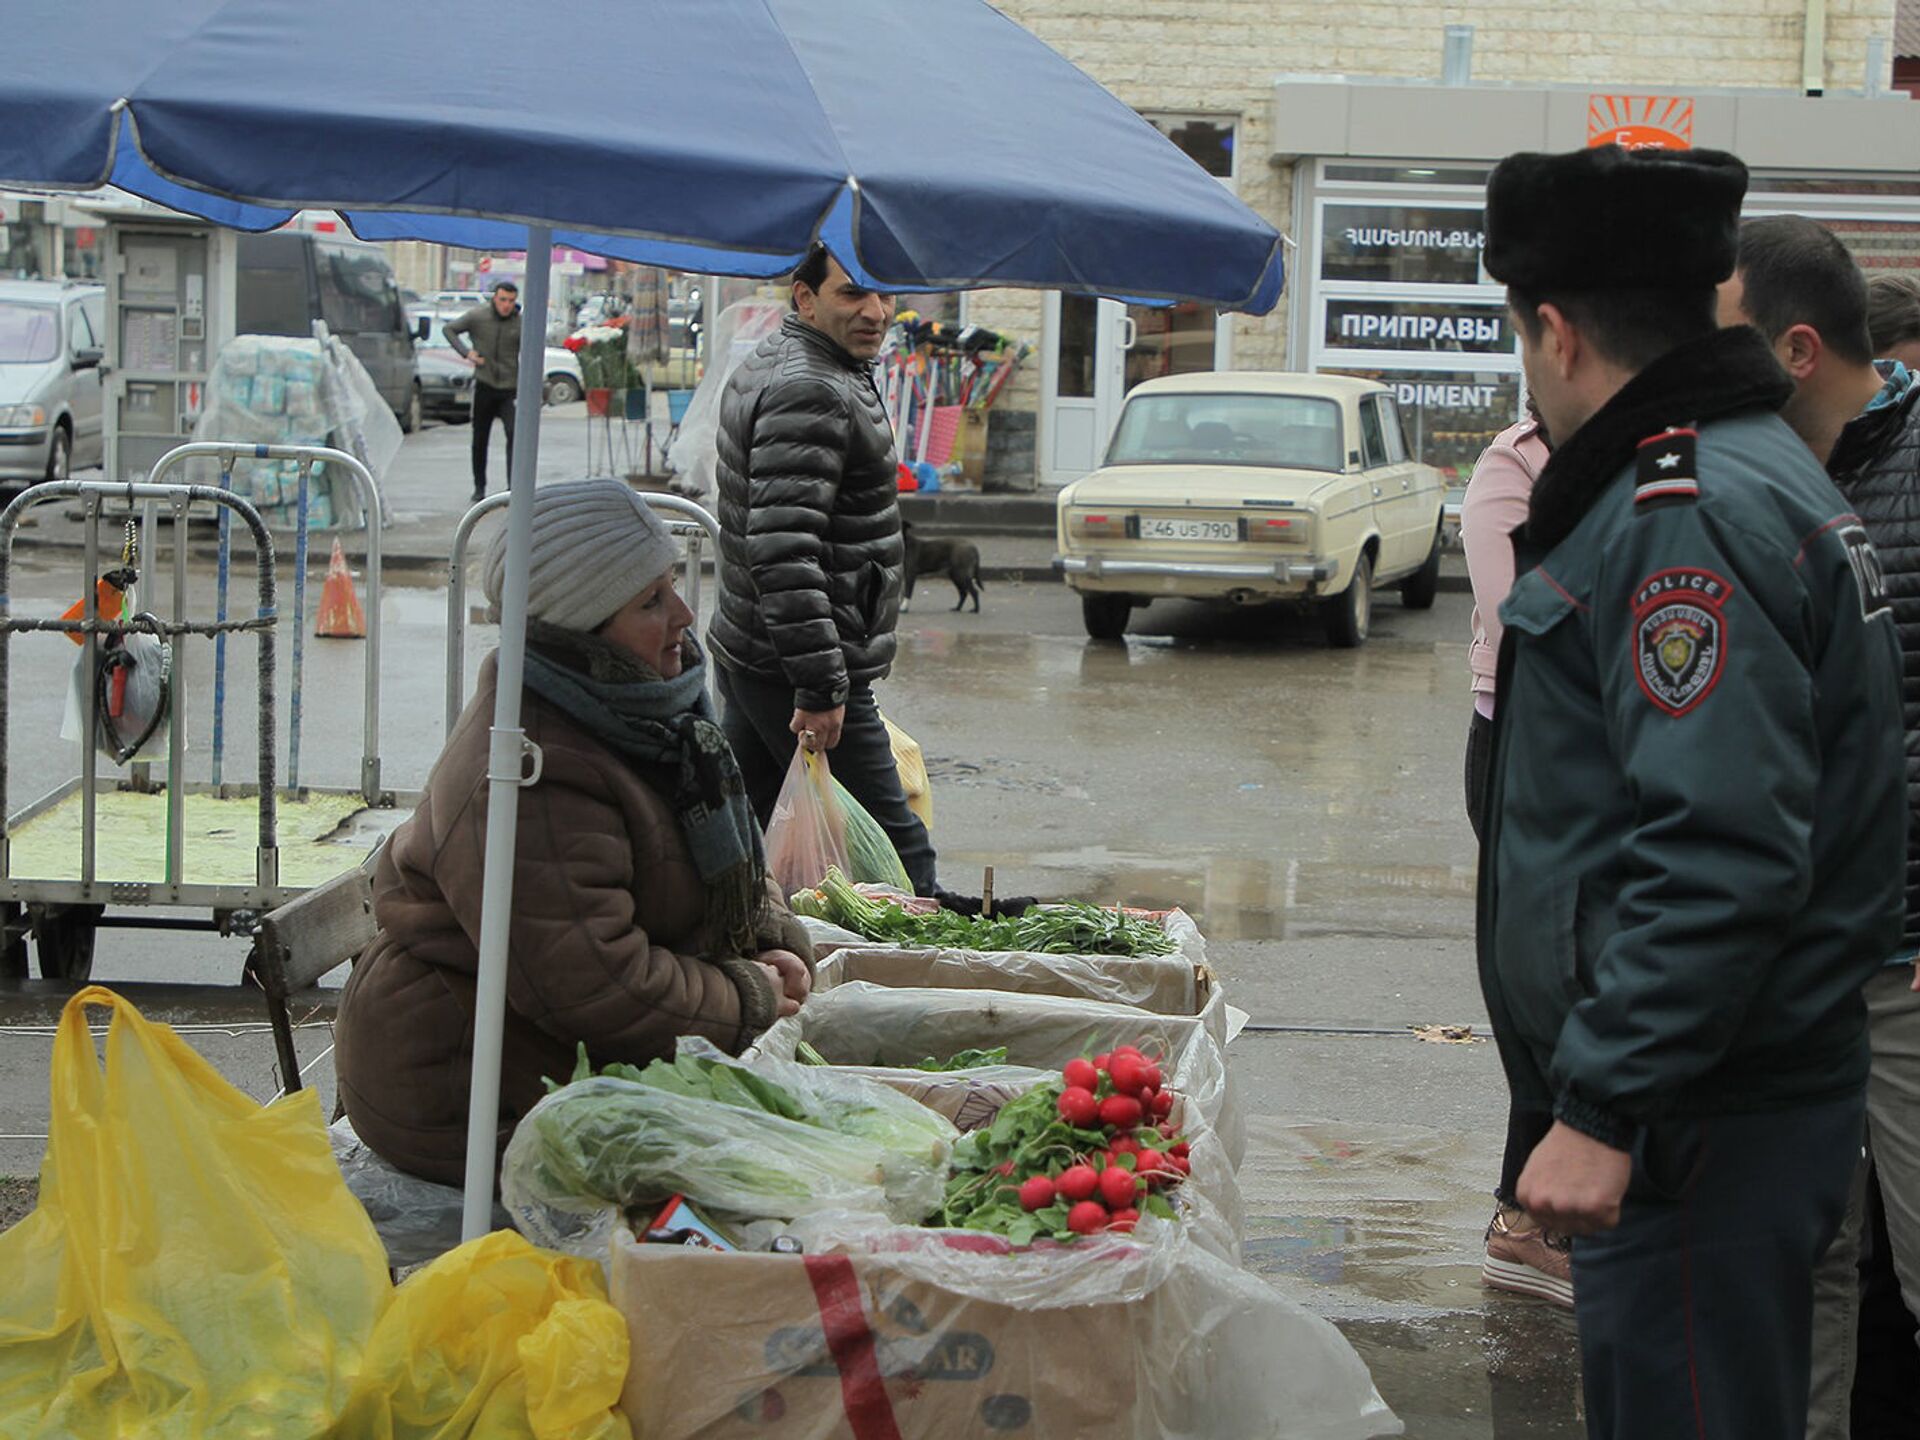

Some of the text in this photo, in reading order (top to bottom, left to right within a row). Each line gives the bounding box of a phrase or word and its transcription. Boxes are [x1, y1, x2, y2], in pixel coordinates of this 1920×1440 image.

[1346, 228, 1486, 248] ՀԱՄԵՄՈՒՆՔՆԵ
[1341, 313, 1500, 341] ПРИПРАВЫ
[1389, 383, 1496, 407] DIMENT
[1155, 521, 1232, 539] 46 US 790
[1640, 575, 1718, 601] POLICE
